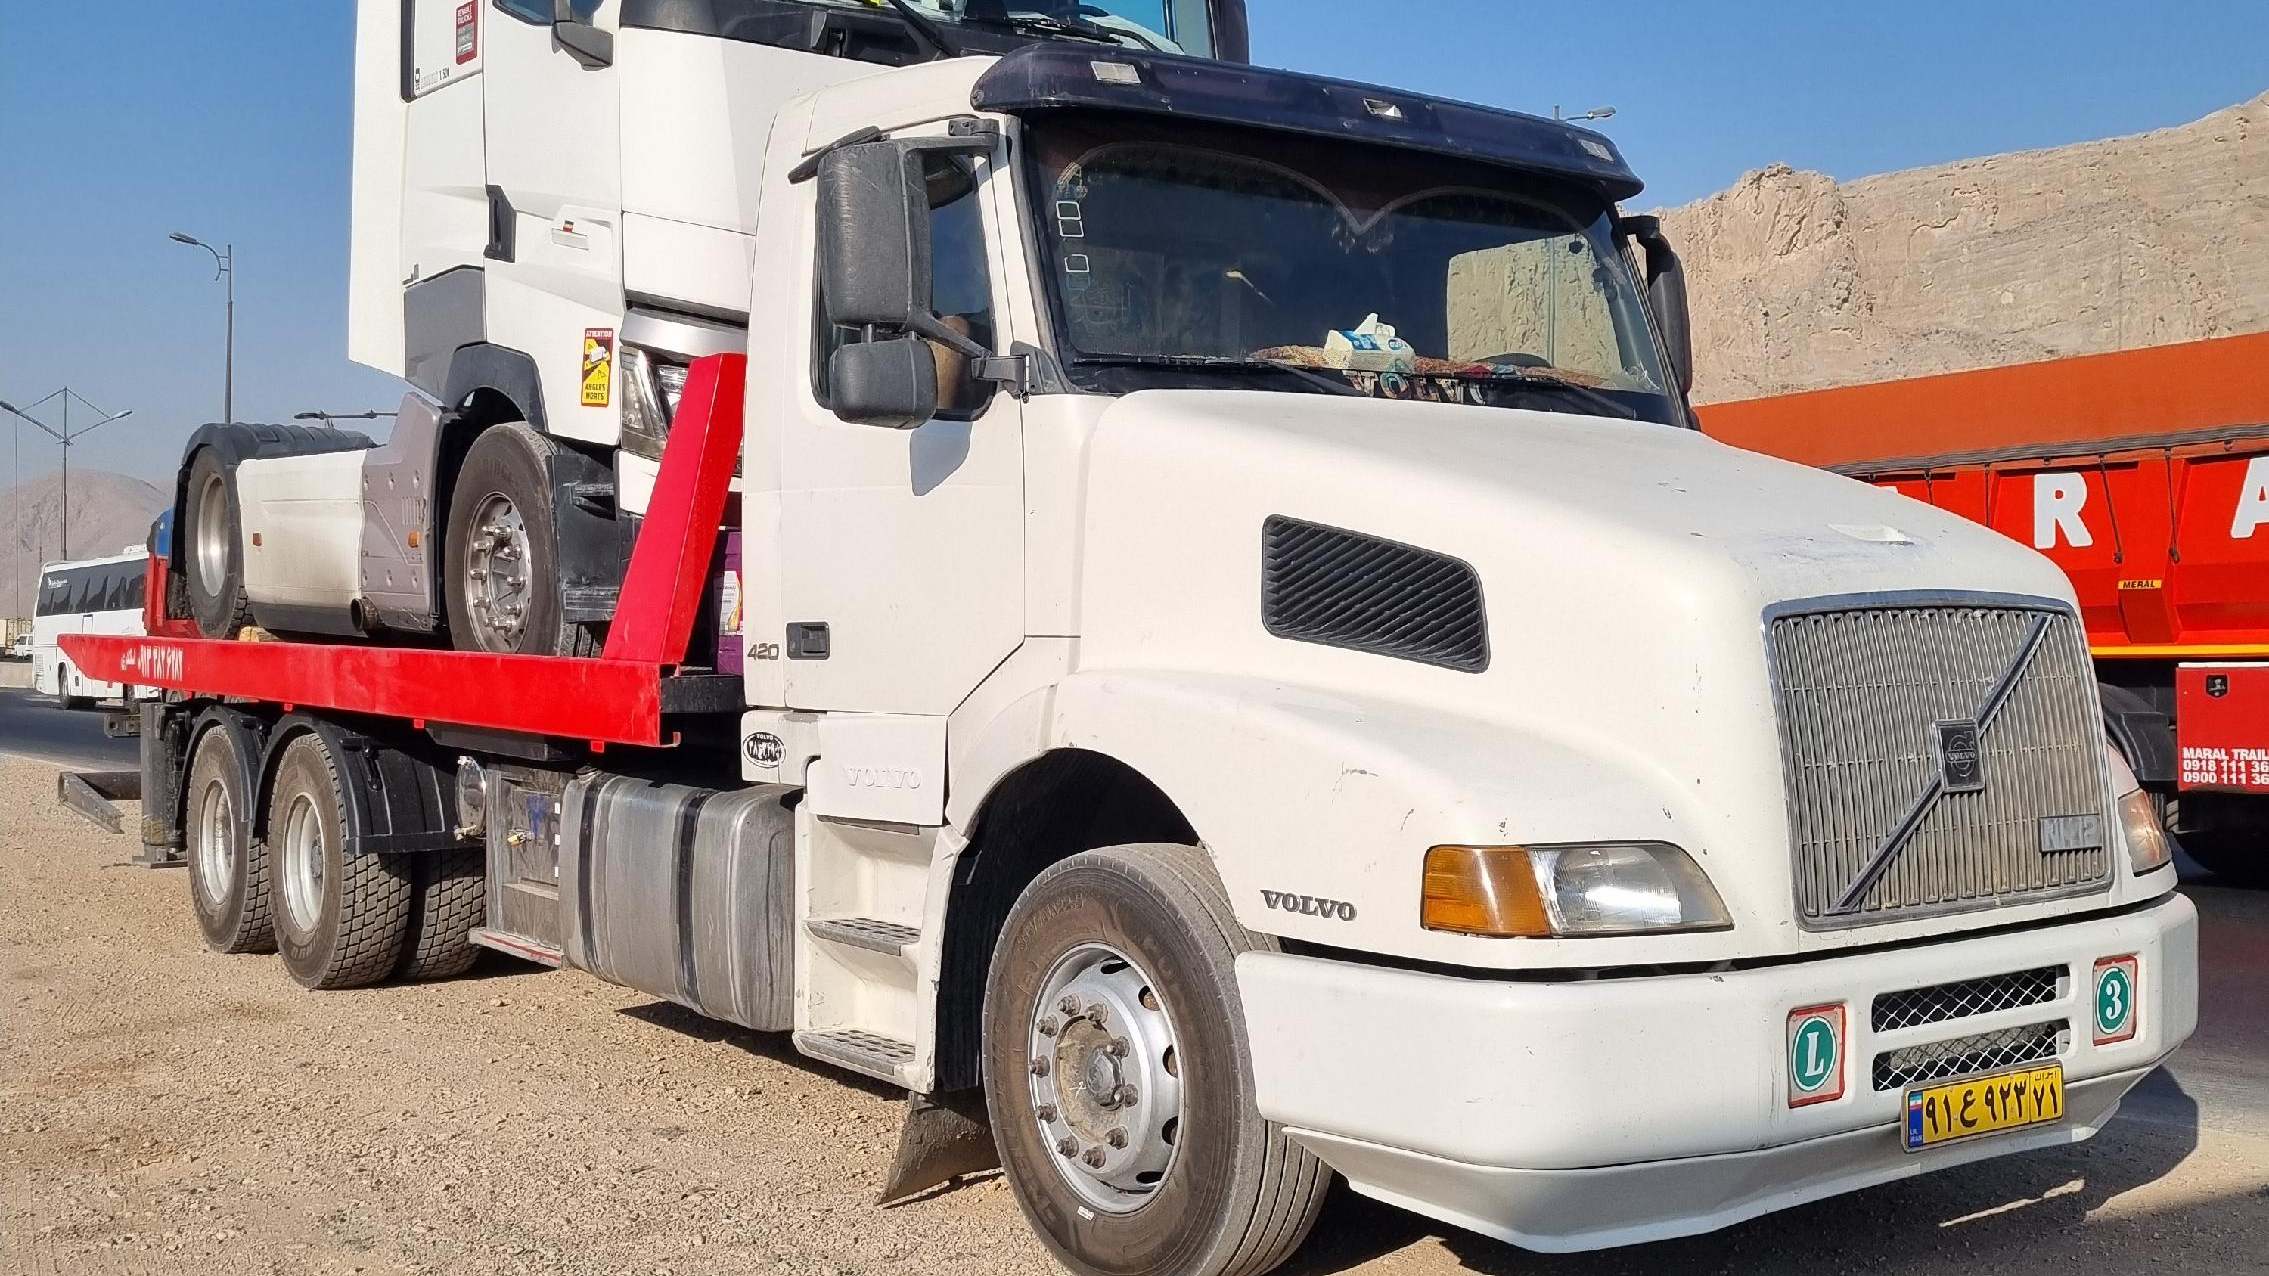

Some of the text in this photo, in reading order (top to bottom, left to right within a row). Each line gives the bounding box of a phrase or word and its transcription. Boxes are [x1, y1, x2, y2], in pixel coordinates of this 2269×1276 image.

[584, 383, 606, 391] ANGLES
[585, 392, 605, 401] MORTS
[2123, 580, 2156, 589] MERAL
[747, 642, 780, 661] 420
[755, 733, 774, 741] VOLVO
[1947, 750, 1977, 763] VOLVO
[2183, 747, 2229, 760] MARAL
[2183, 759, 2217, 771] 0918
[2220, 760, 2246, 773] 111
[845, 766, 922, 790] VOLVO
[2183, 771, 2218, 783] 0900
[2220, 772, 2247, 785] 111
[1259, 889, 1358, 922] VOLVO
[2105, 978, 2122, 1021] 3
[1804, 1031, 1826, 1078] L
